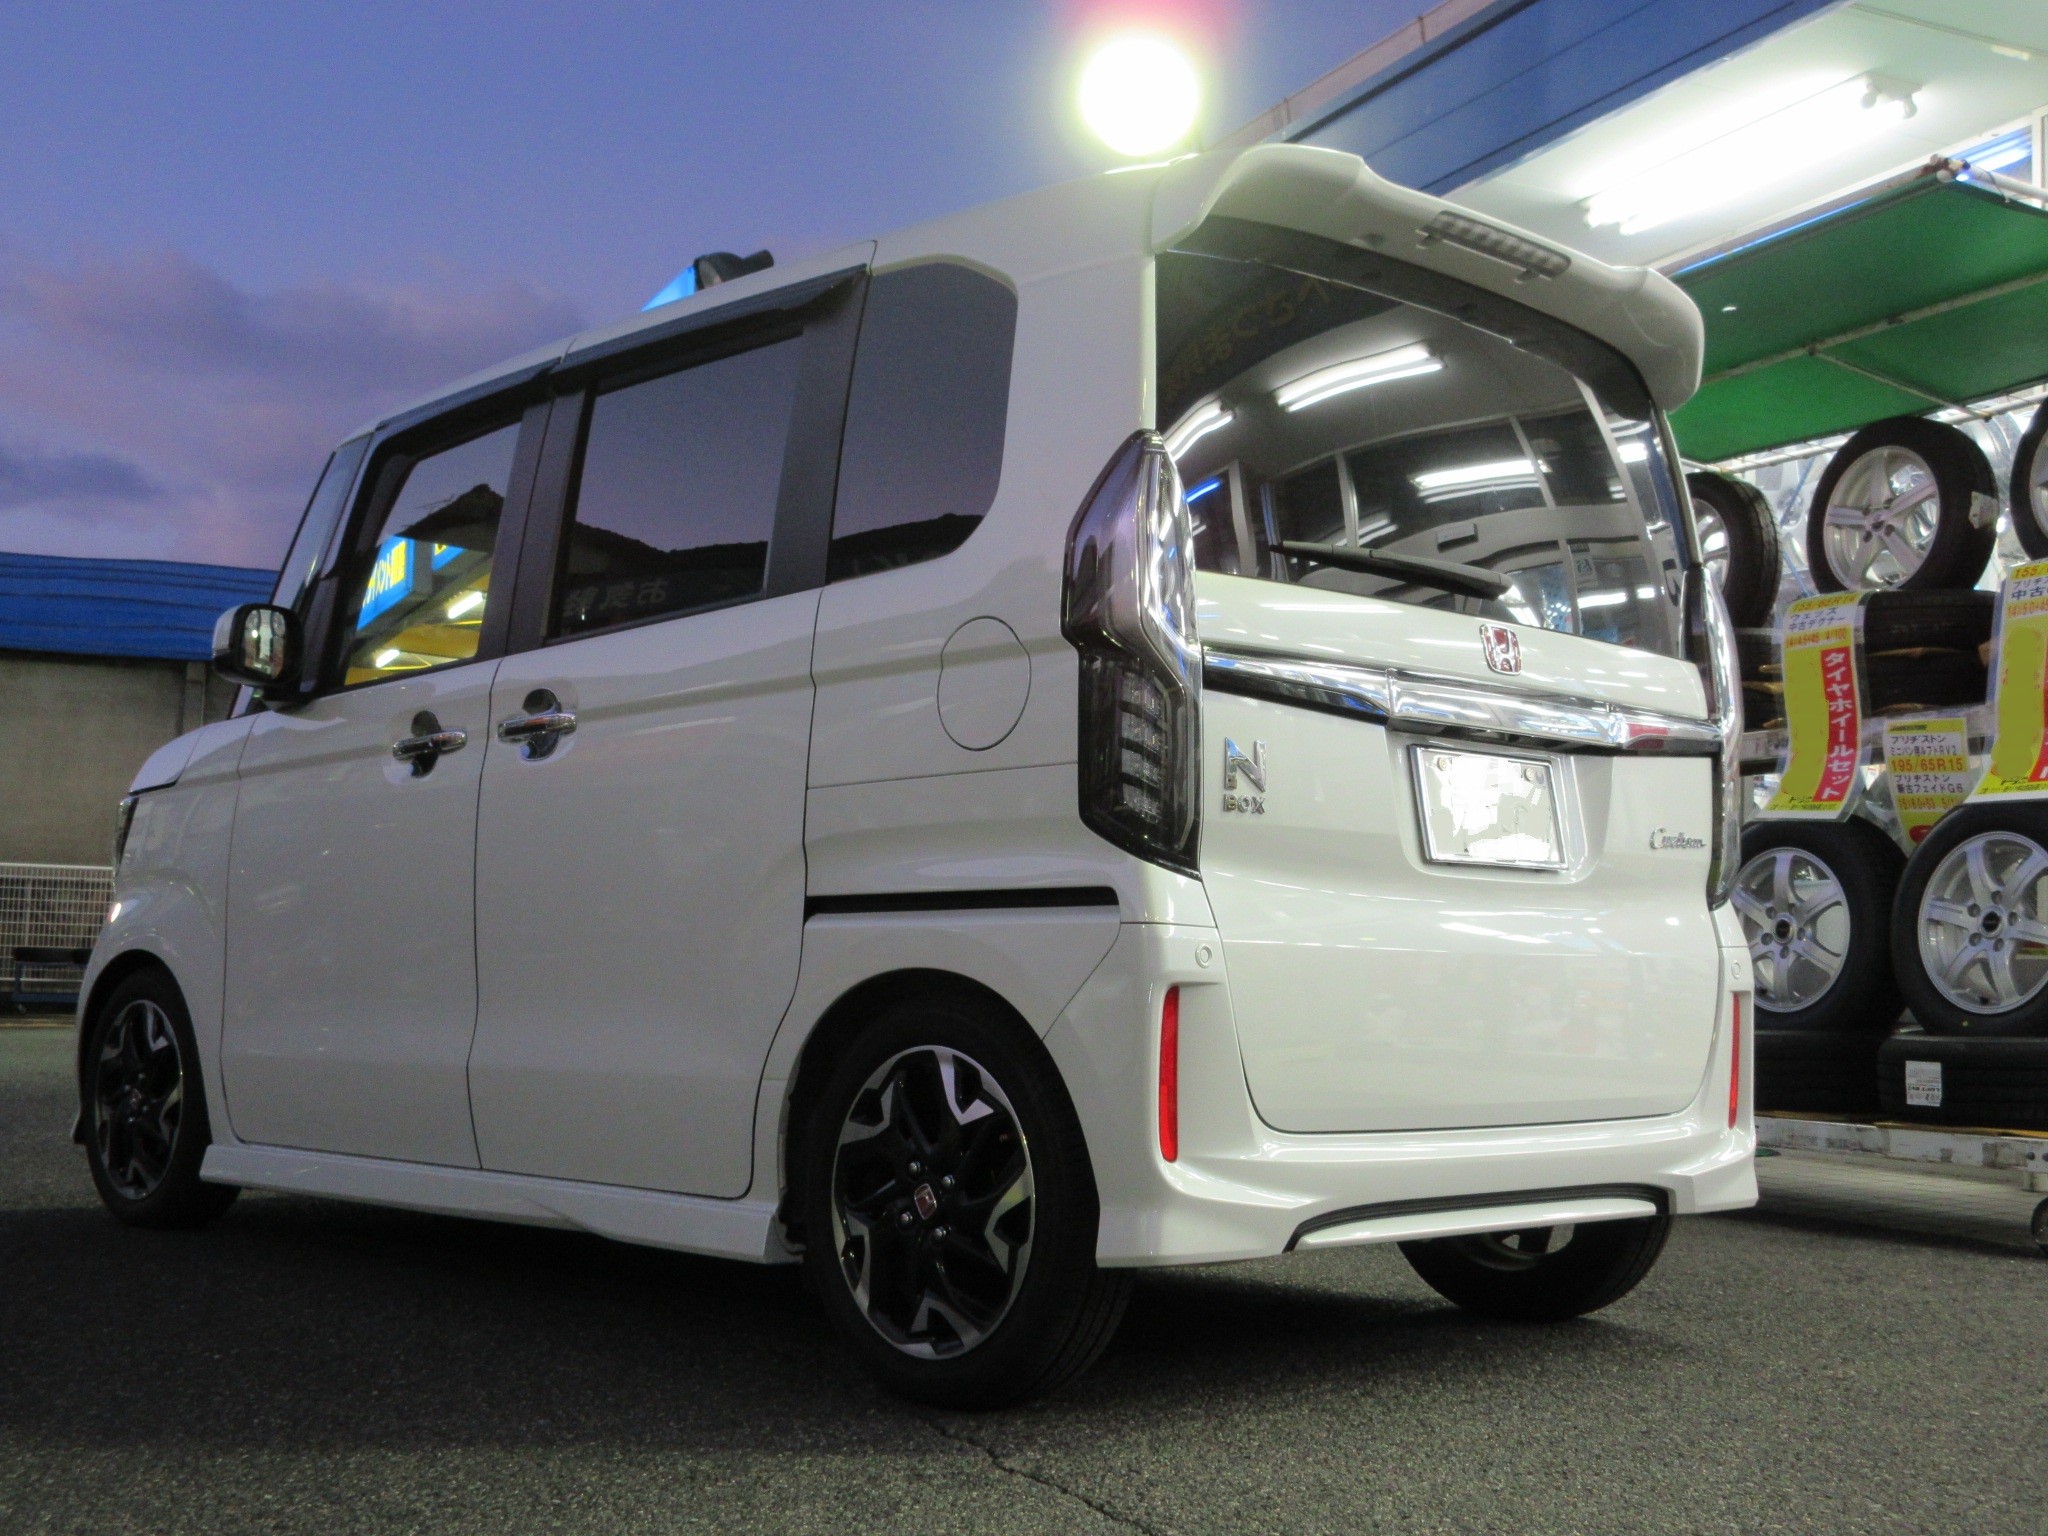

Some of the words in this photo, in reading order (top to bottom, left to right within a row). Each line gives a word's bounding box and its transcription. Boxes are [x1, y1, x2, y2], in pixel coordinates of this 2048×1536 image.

[1821, 651, 1854, 800] タイヤホイールセット
[1224, 736, 1267, 792] N
[1223, 794, 1266, 815] BOX
[1650, 827, 1707, 850] Custom
